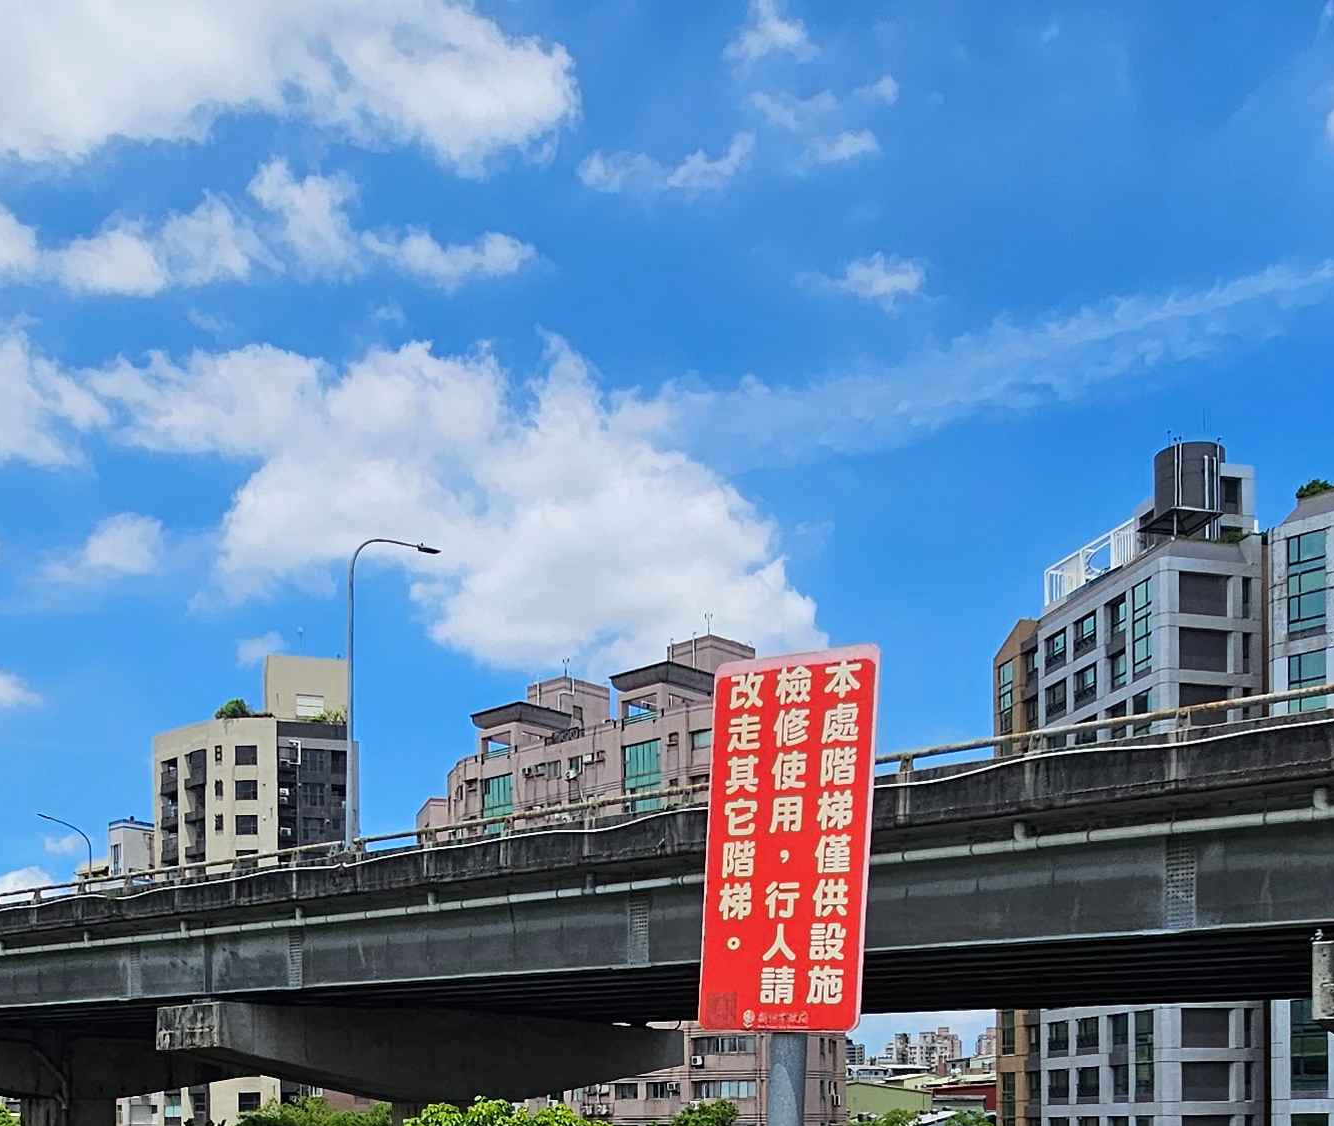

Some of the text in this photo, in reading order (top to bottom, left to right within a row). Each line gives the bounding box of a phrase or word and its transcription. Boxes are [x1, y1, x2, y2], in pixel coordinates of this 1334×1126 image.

[719, 672, 765, 950] 改走其它階梯。
[759, 665, 812, 1004] 檢修使用，行人請
[806, 660, 862, 1004] 本處階梯僅供設施
